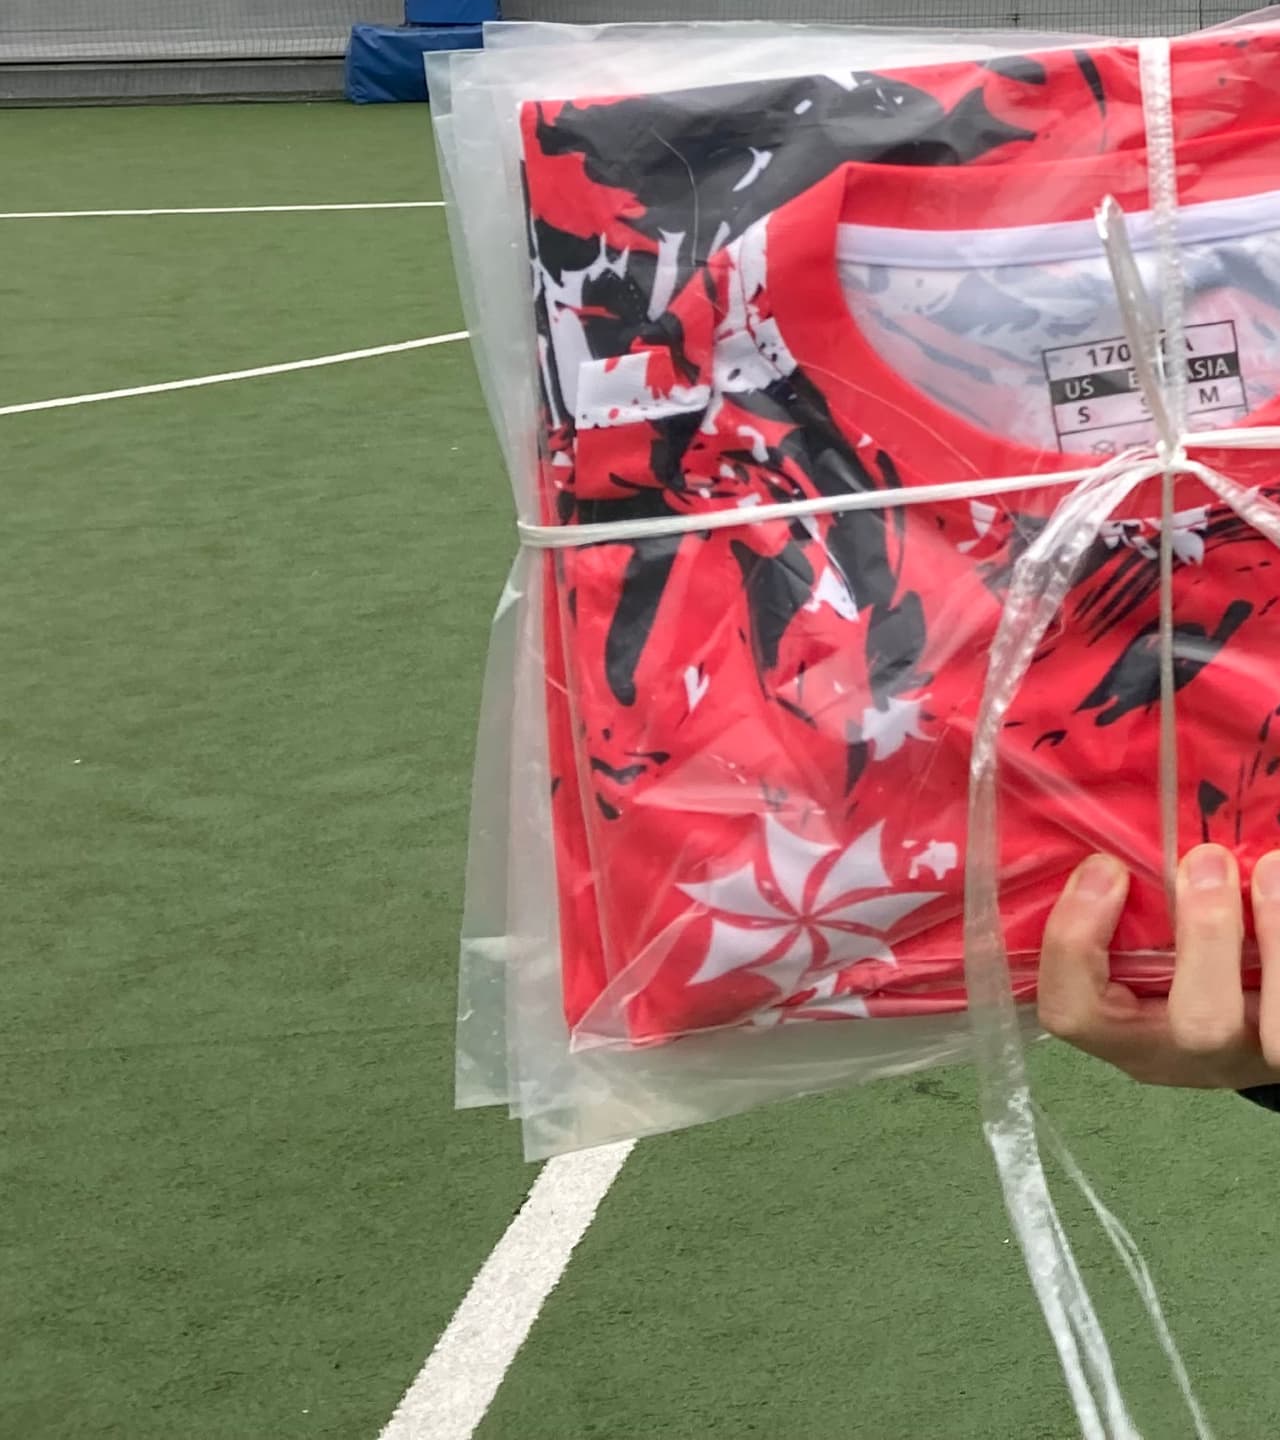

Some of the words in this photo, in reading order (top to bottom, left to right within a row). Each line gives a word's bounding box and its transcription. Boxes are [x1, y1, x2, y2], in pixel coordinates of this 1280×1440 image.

[1065, 377, 1095, 399] US
[1077, 405, 1091, 424] S
[1199, 385, 1220, 404] M
